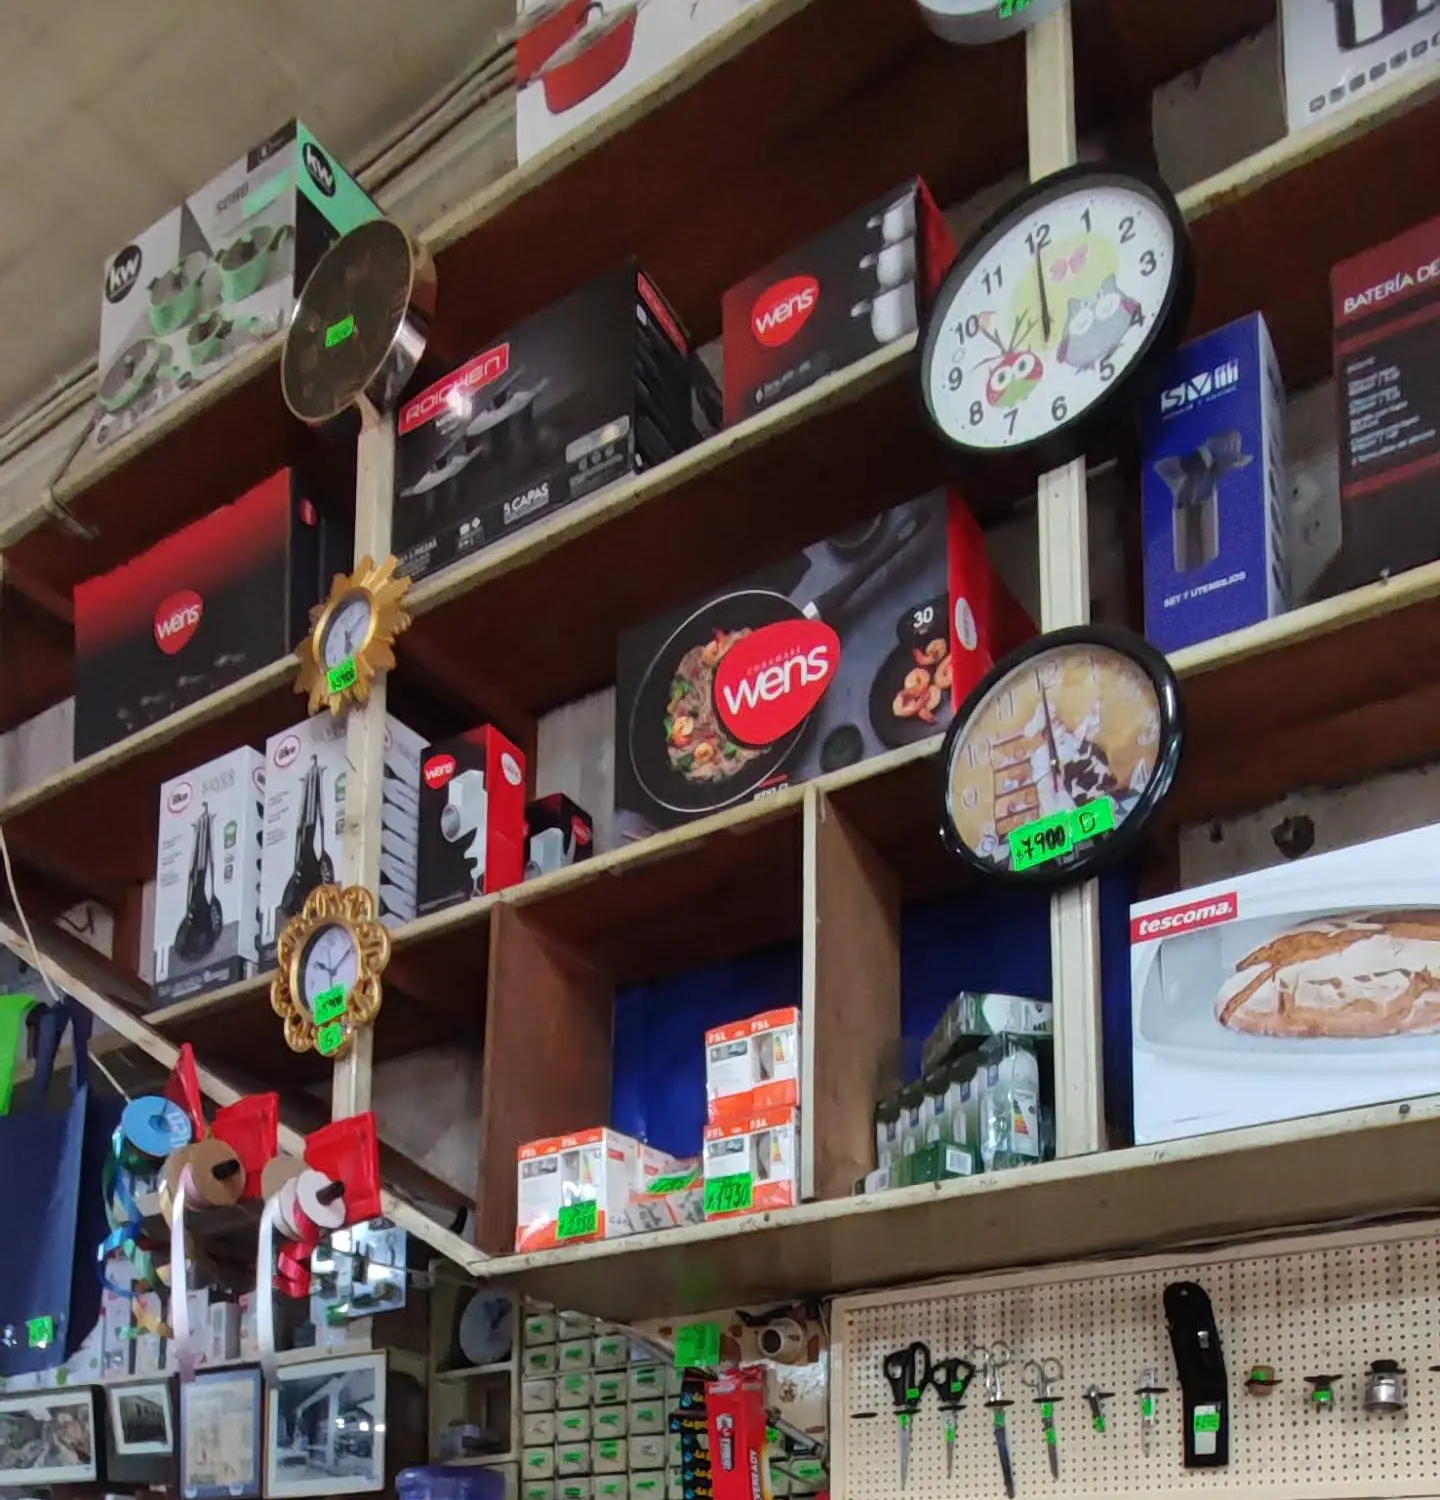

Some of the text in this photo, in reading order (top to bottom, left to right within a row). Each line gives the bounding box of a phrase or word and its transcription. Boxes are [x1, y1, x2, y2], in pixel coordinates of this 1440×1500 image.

[1080, 207, 1092, 232] 1
[1118, 216, 1136, 244] 2
[1025, 224, 1052, 254] 12
[1139, 250, 1157, 277] 3
[980, 265, 1003, 295] 11
[1343, 271, 1414, 316] BATERÍA
[755, 286, 818, 334] wens
[1130, 303, 1145, 328] 4
[954, 314, 980, 345] 10
[948, 366, 962, 391] 9
[1100, 355, 1115, 382] 5
[969, 400, 984, 426] 8
[1003, 408, 1019, 435] 7
[1051, 396, 1067, 421] 6
[512, 482, 549, 513] CAPAS
[156, 604, 201, 639] wens
[913, 606, 934, 628] 30
[723, 645, 829, 715] wens
[1016, 825, 1066, 861] $7900
[1139, 901, 1233, 936] tescoma.
